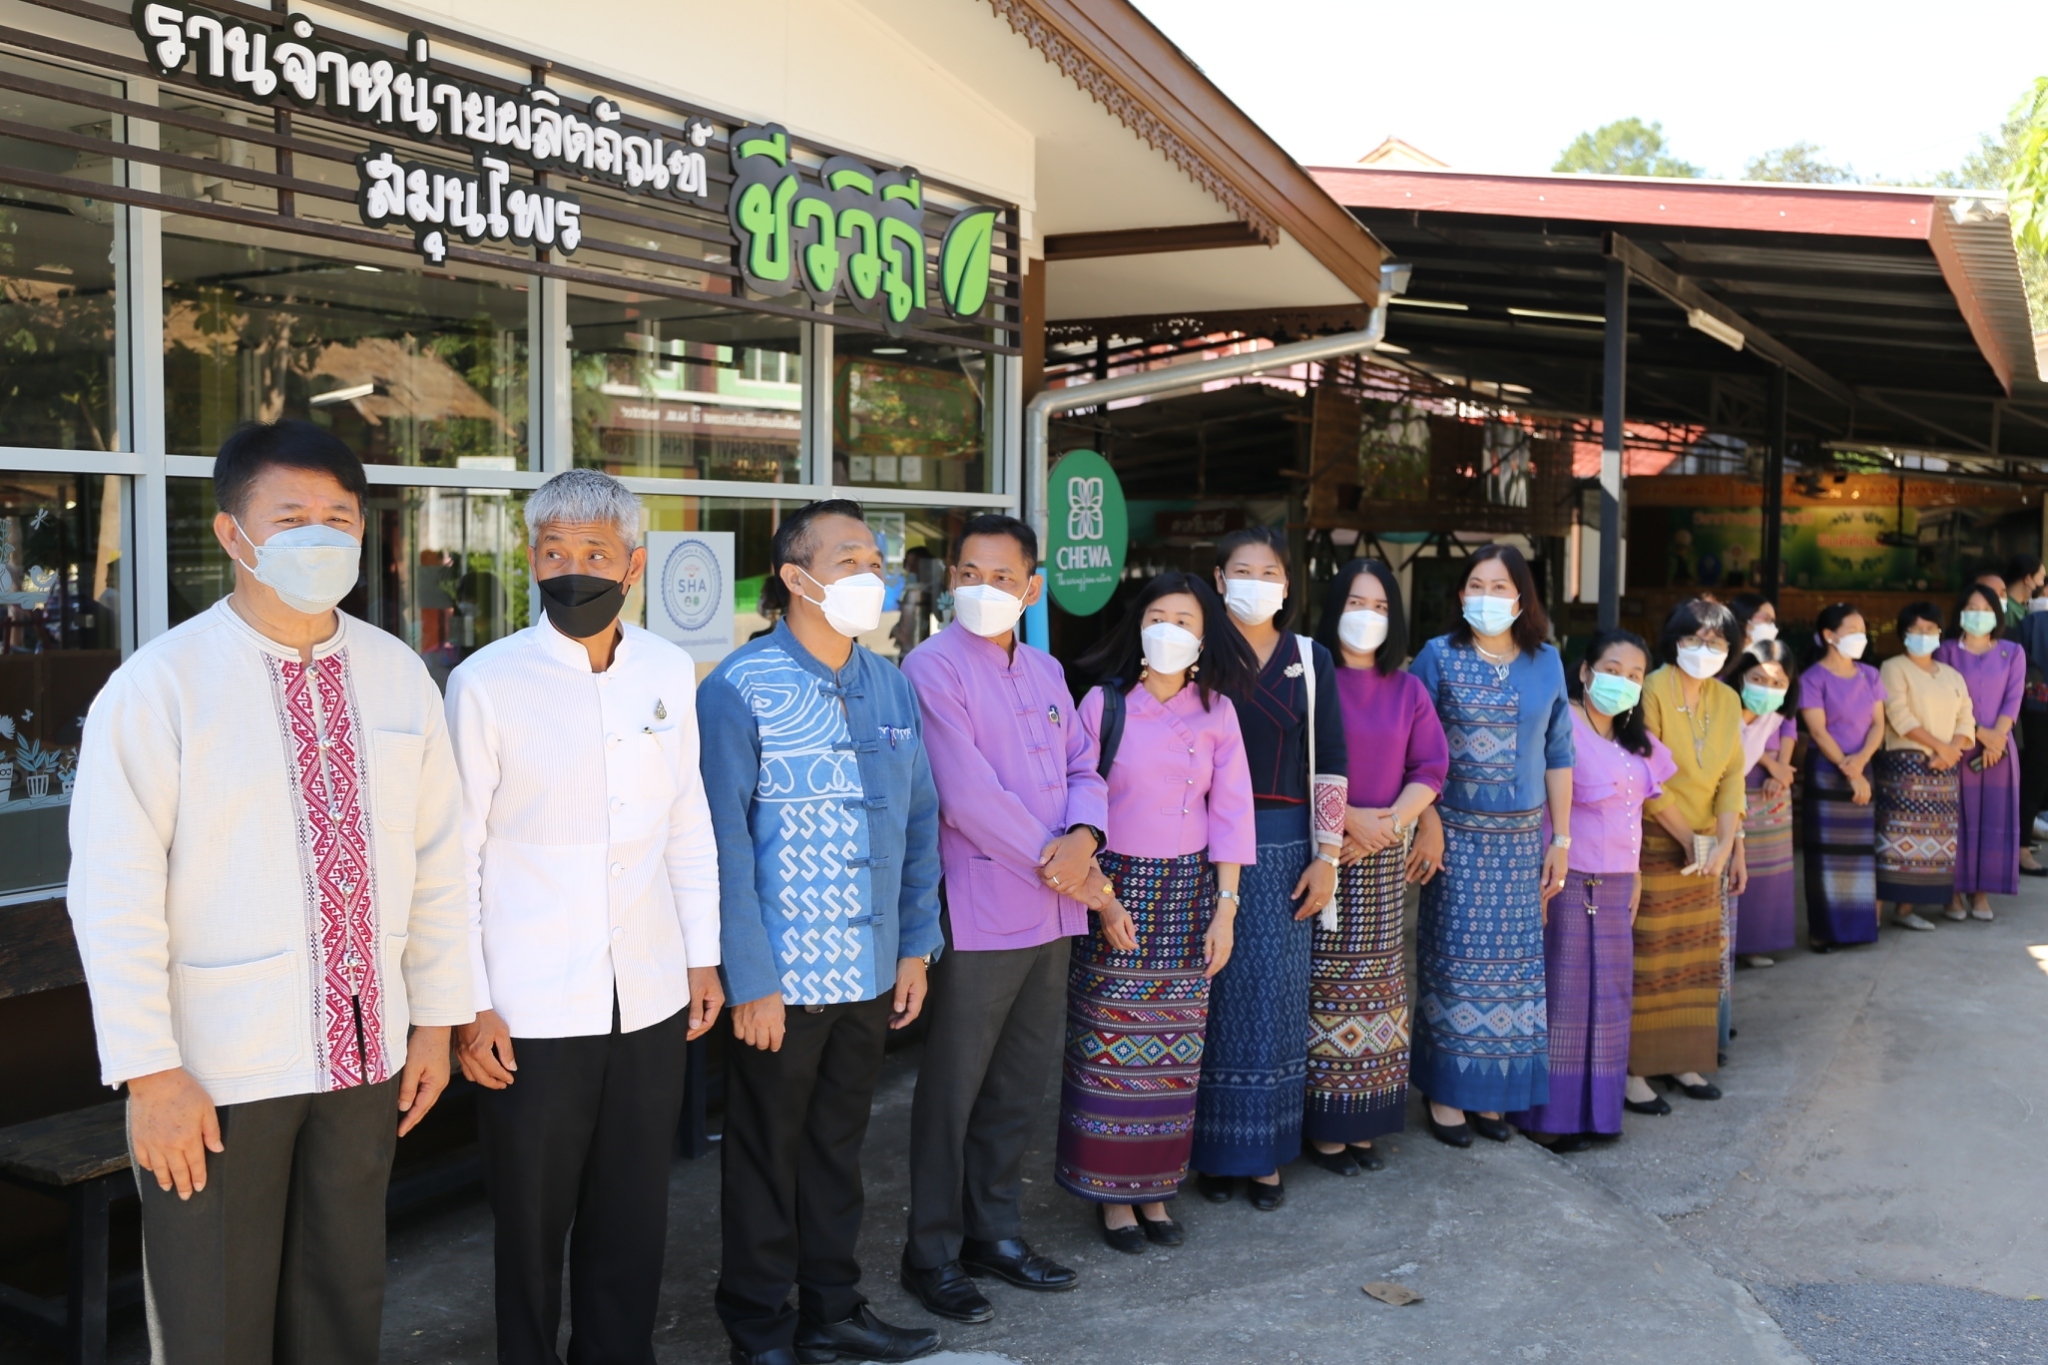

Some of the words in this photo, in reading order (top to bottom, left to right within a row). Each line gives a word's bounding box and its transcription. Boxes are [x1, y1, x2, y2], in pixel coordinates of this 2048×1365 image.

[366, 152, 582, 262] สมุนไพร
[738, 132, 926, 322] ชีววิถี
[678, 579, 707, 593] SHA
[1056, 545, 1112, 571] CHEWA
